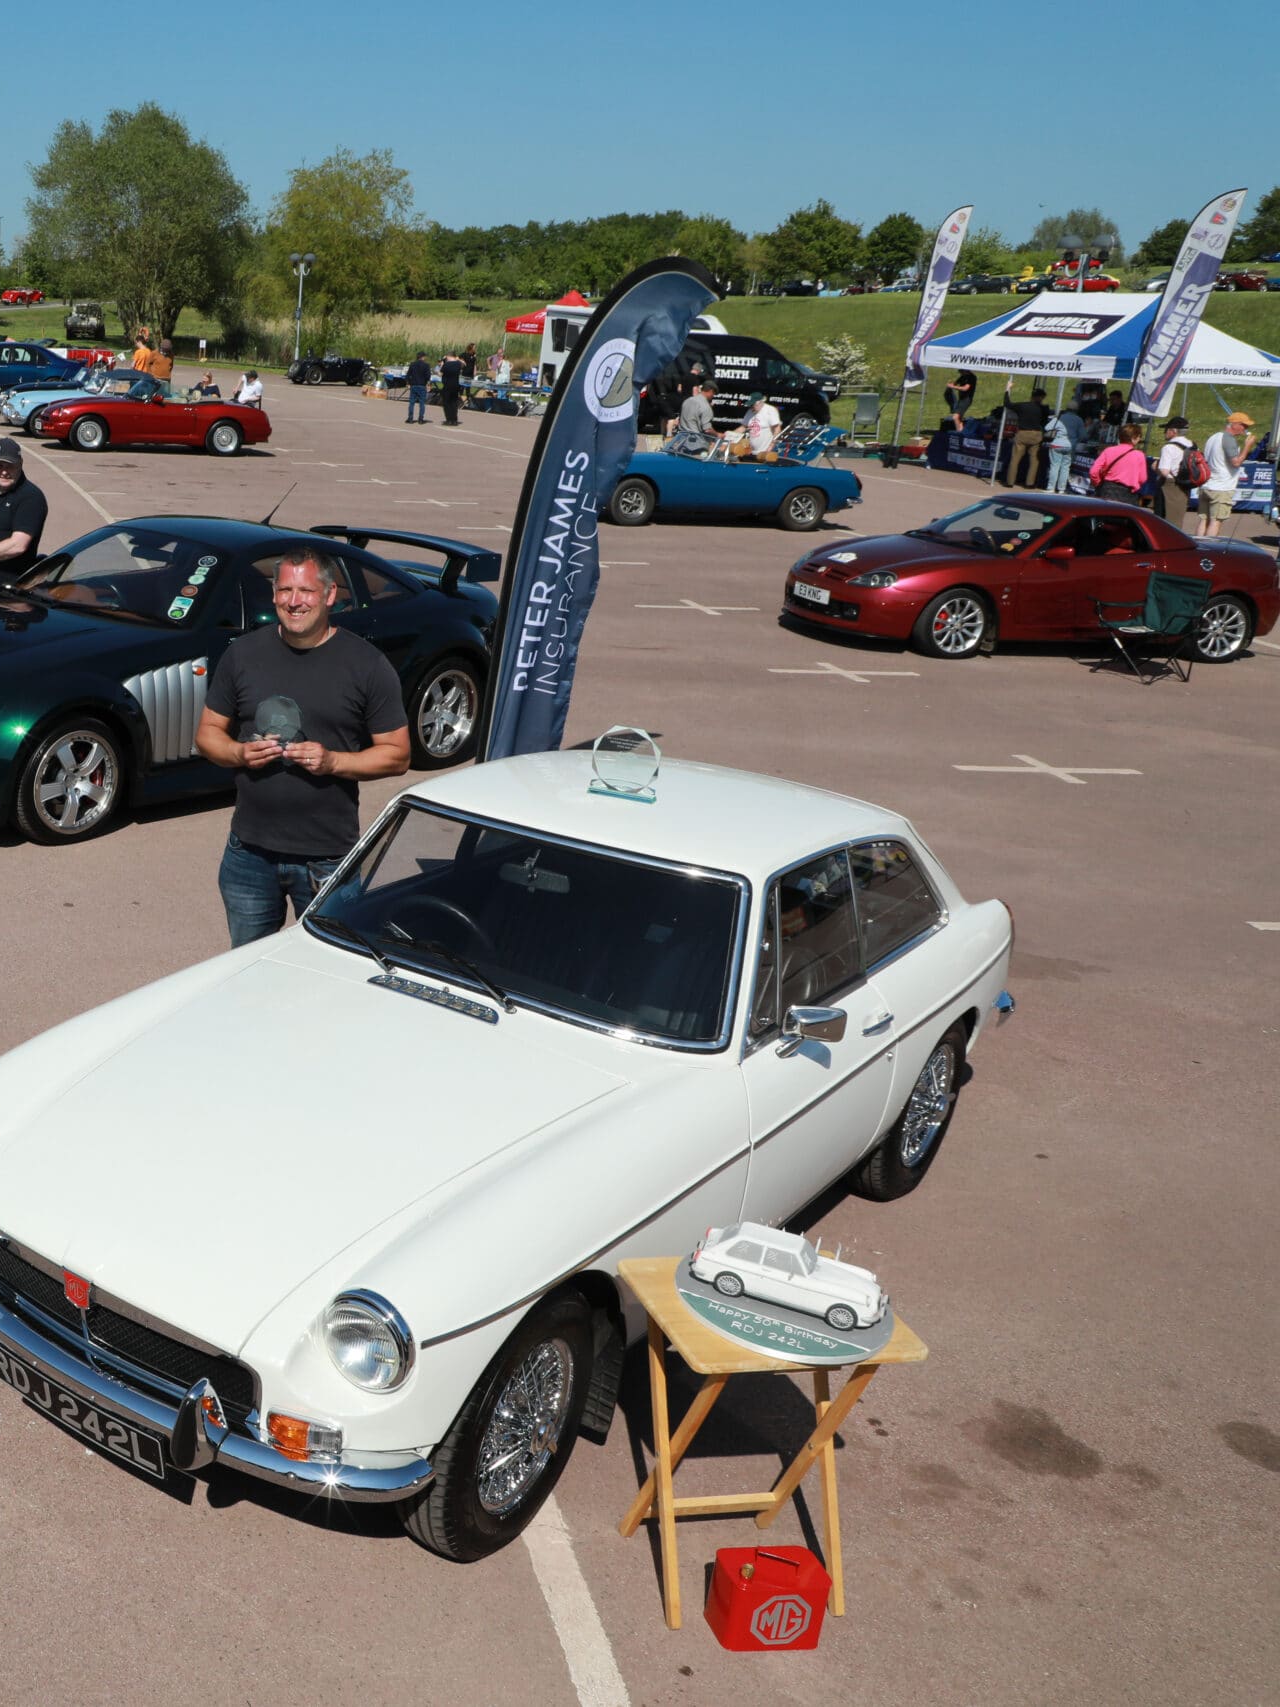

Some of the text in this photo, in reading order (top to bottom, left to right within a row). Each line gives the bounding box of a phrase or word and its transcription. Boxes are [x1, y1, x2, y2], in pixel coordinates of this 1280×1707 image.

[1013, 316, 1101, 335] RIMMER
[1136, 281, 1217, 396] RIMMER
[1169, 315, 1200, 356] BROS
[714, 368, 750, 380] SMITH
[715, 355, 760, 368] MARTIN
[949, 353, 1083, 373] www.rimmerbros.co.uk
[513, 449, 590, 692] PETER JAMES
[533, 493, 598, 695] INSURANCE
[708, 1302, 751, 1321] Happy
[784, 1325, 838, 1350] Birthday
[730, 1320, 807, 1351] RDJ 242L
[759, 1601, 803, 1640] MG
